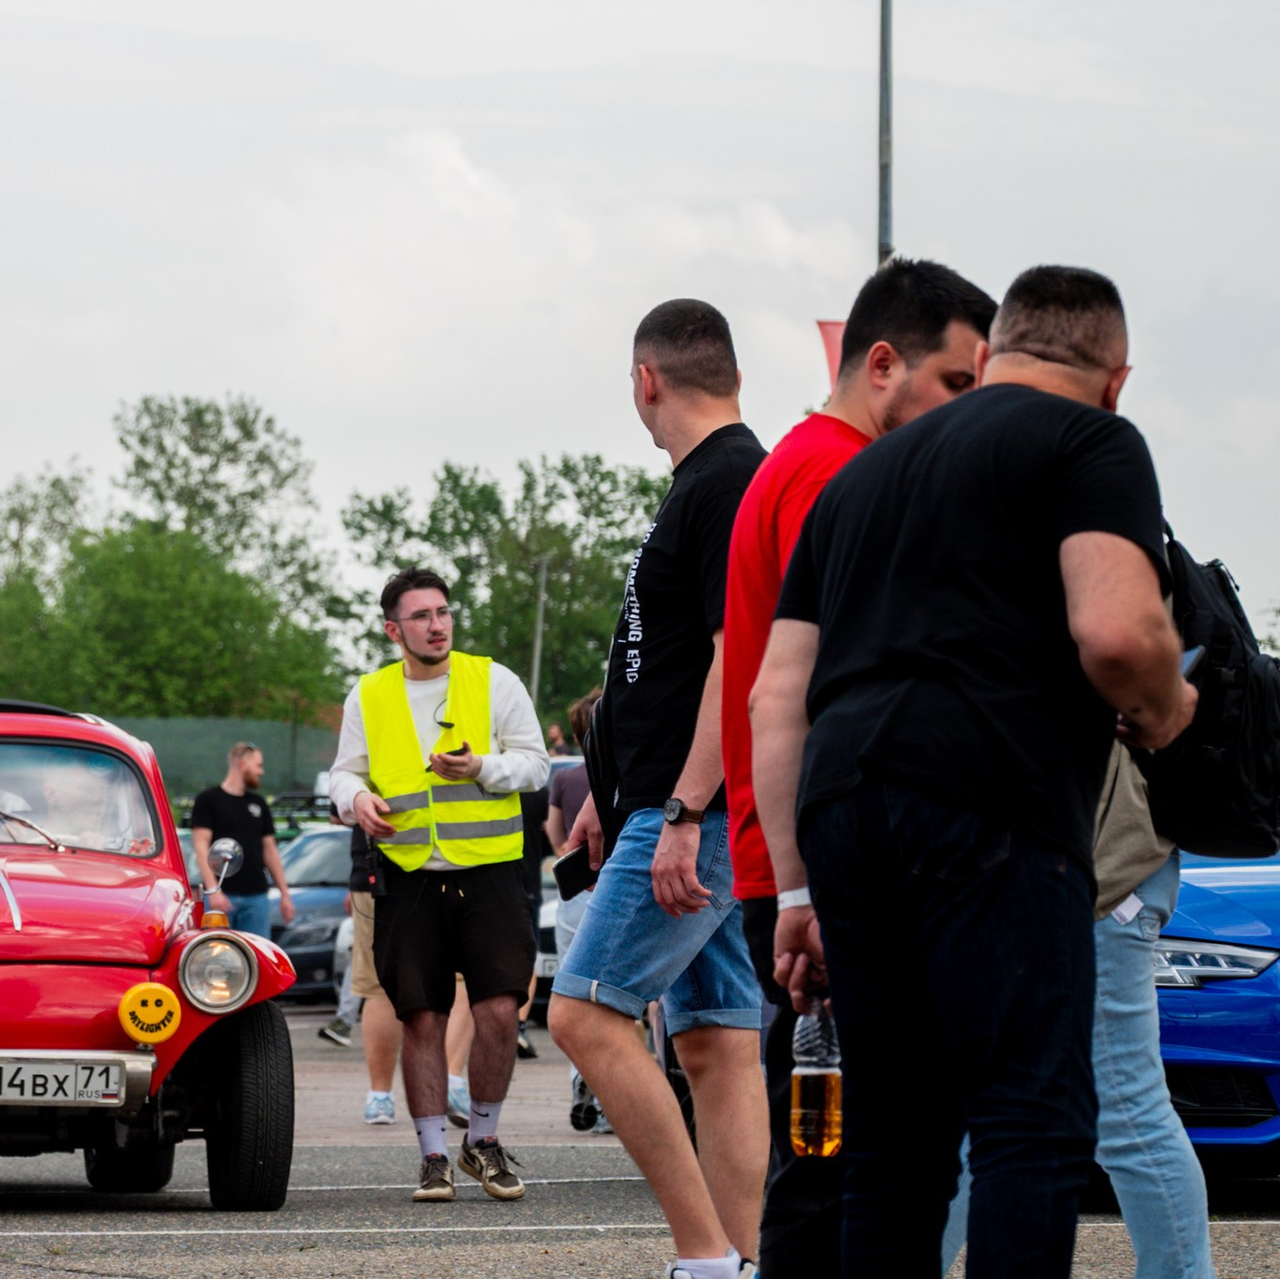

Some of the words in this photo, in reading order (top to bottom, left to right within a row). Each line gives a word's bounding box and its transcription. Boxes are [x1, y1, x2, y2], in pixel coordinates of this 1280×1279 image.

[626, 647, 641, 683] EPIC
[128, 1010, 174, 1033] DAYLIGHTER
[80, 1066, 111, 1090] 71
[78, 1090, 101, 1099] RUS
